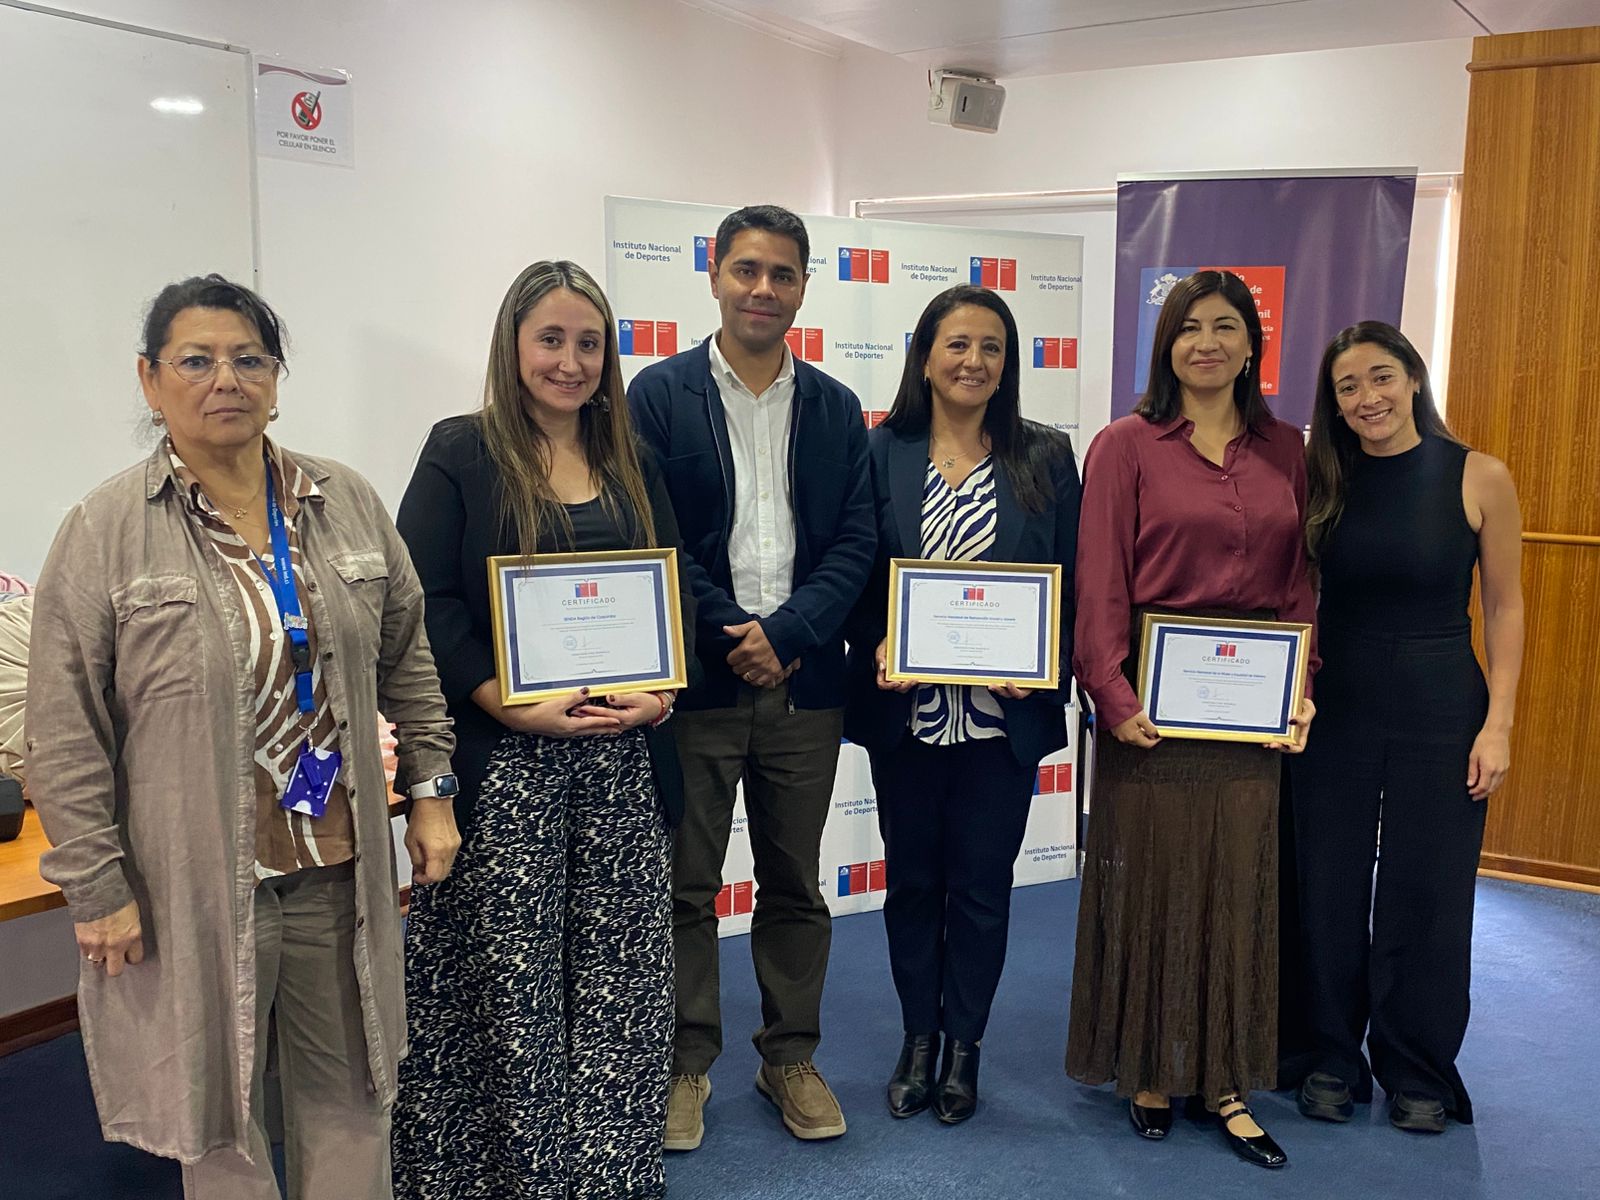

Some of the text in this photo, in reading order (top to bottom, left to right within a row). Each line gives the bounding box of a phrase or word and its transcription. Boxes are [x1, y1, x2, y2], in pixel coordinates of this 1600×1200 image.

[276, 131, 335, 146] POR FAVOR PONER EL
[278, 140, 303, 149] CELULAR
[312, 145, 336, 154] SILENCIO
[613, 240, 681, 253] Instituto Nacional
[625, 251, 671, 262] de Deportes
[807, 257, 827, 265] ional
[901, 262, 958, 273] Instituto Nacional
[911, 272, 948, 282] de Deportes
[1031, 274, 1082, 283] Instituto Nacional
[1039, 282, 1074, 291] de Deportes
[1249, 285, 1262, 294] de
[835, 342, 893, 351] Instituto Nacional
[845, 351, 884, 360] de Deportes
[561, 598, 616, 606] CERTIFICADO
[950, 600, 1000, 608] CERTIFICADO
[1201, 656, 1250, 665] CERTIFICADO
[834, 800, 863, 809] Instituto
[844, 806, 878, 816] de Deport
[732, 817, 748, 825] cion
[1024, 844, 1075, 856] Instituto Nacional
[1041, 853, 1067, 861] Deportes
